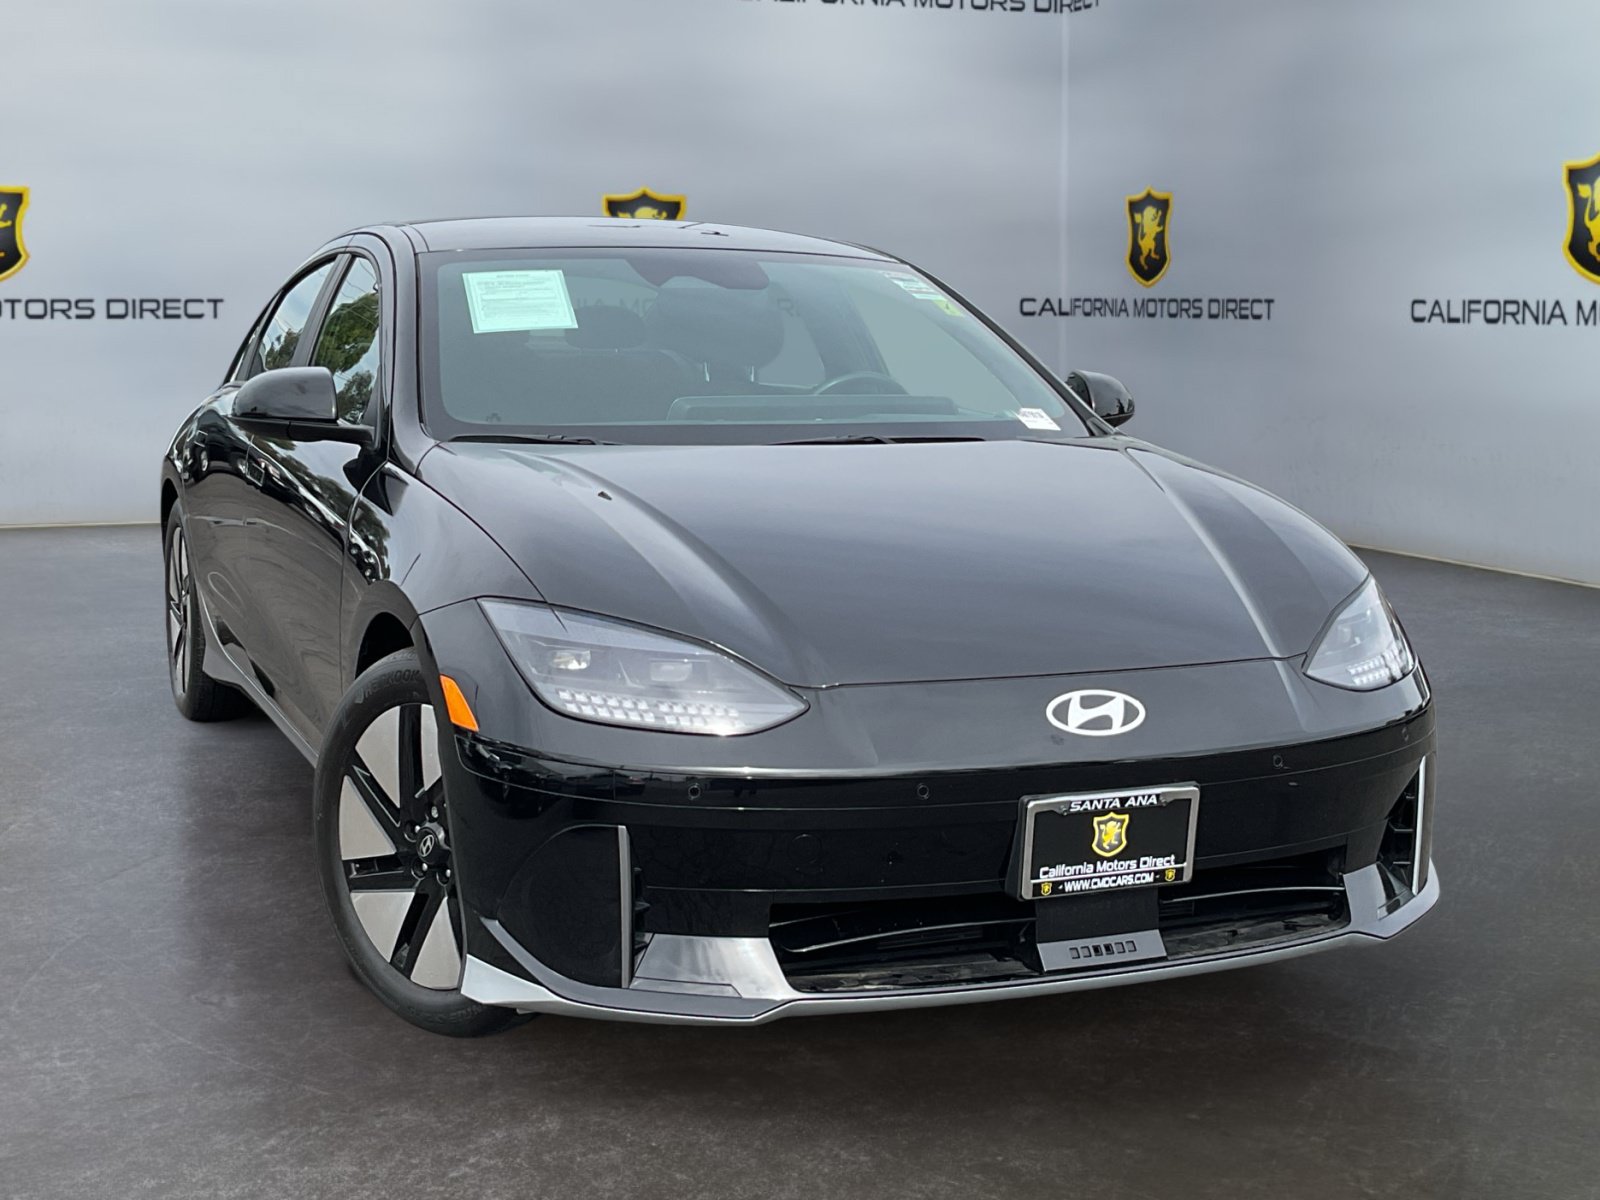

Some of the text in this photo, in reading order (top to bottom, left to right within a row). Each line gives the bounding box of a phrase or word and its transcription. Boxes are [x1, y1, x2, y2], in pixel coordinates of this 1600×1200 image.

[0, 298, 224, 320] TORS DIRECT
[1019, 297, 1275, 320] CALIFORNIA MOTORS DIRECT
[1411, 299, 1600, 326] CALIFORNIA M
[1070, 794, 1157, 812] SANTA ANA
[1039, 854, 1175, 879] California Motors Direct
[1064, 872, 1154, 892] WWW.CMDCARS.COM
